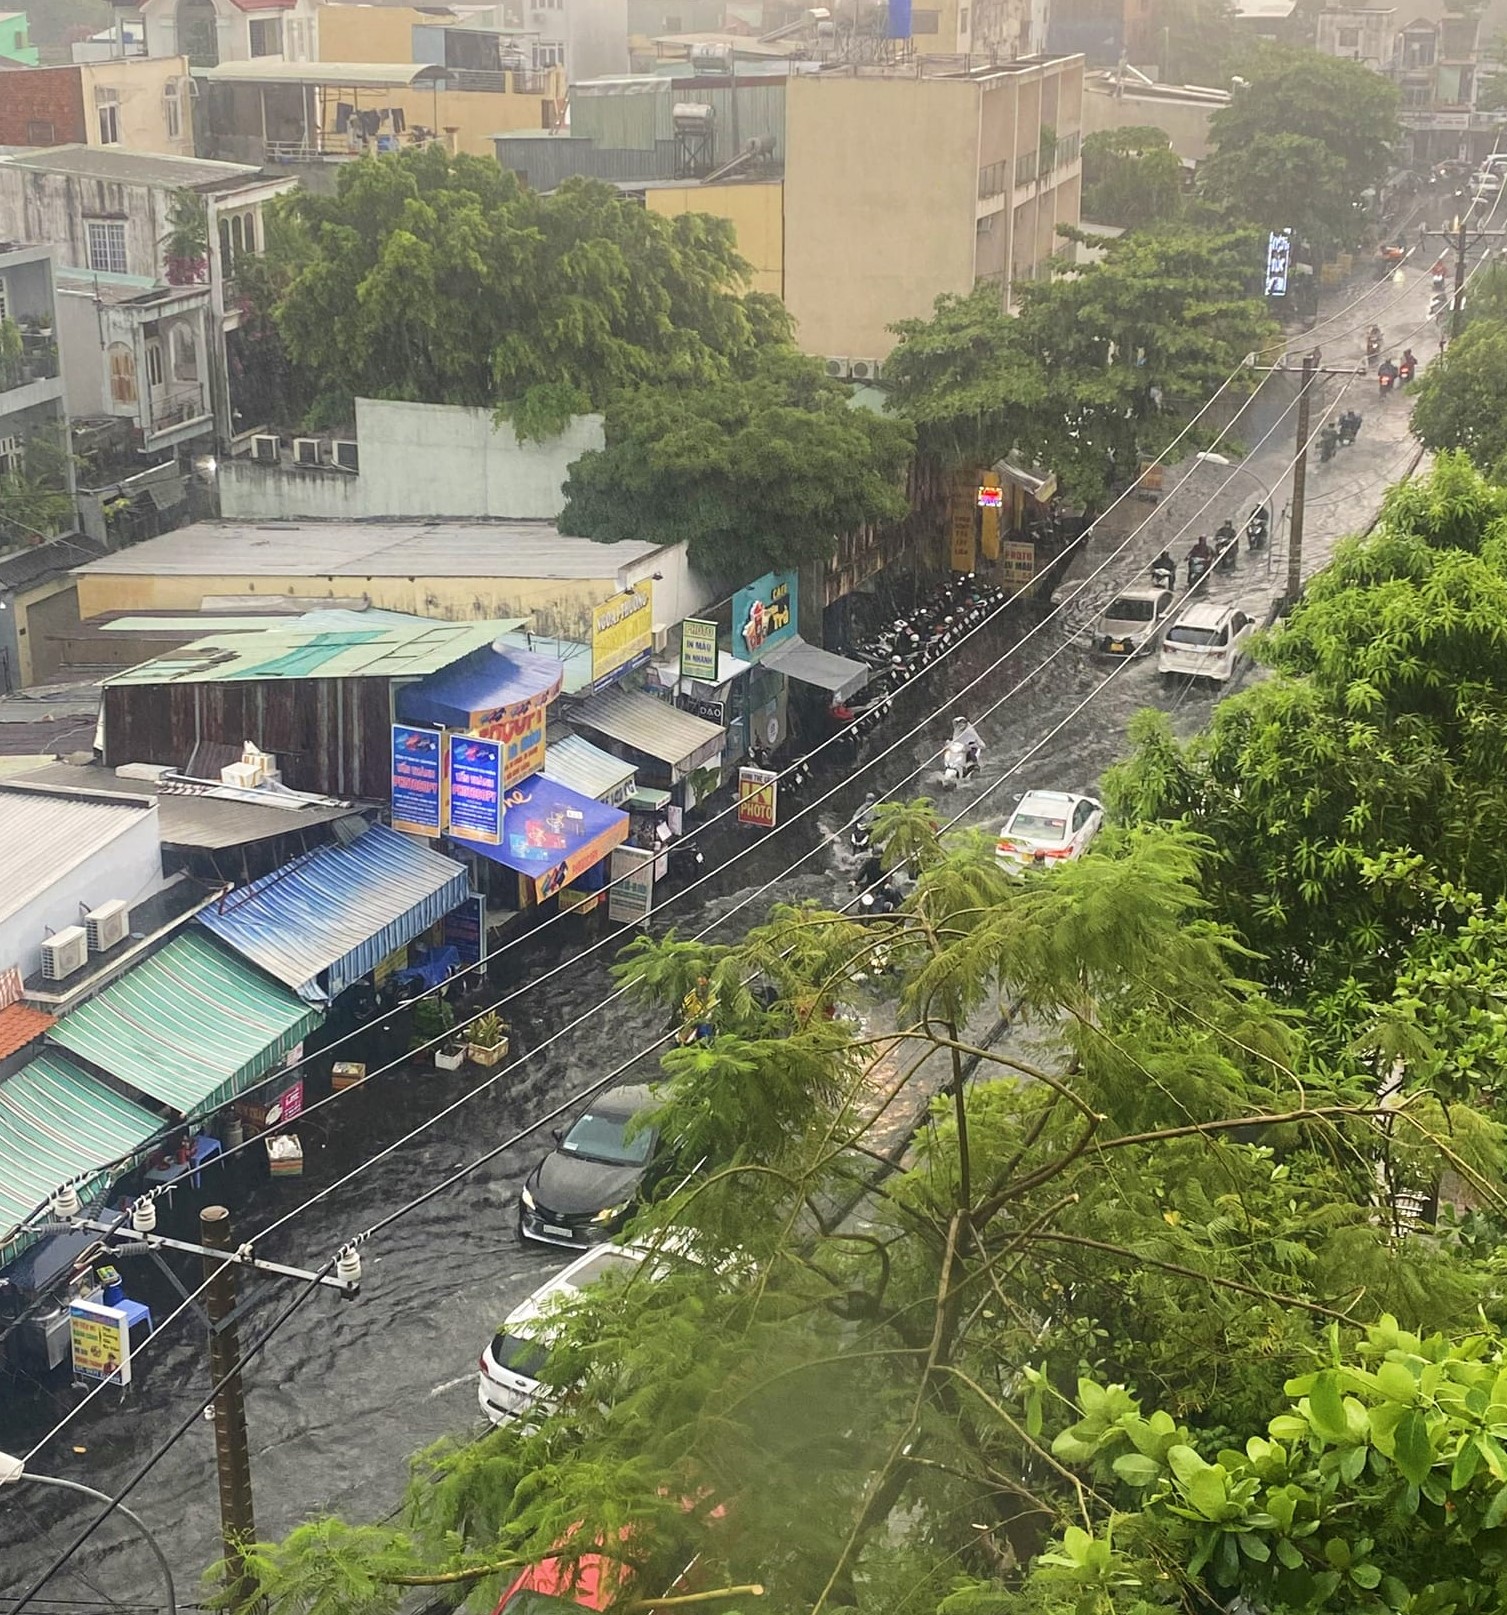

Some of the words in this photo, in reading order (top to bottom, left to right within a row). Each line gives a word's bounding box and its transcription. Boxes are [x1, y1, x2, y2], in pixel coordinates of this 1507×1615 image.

[685, 624, 715, 637] PHOTO
[686, 640, 694, 648] IN
[740, 802, 772, 820] PHOTO
